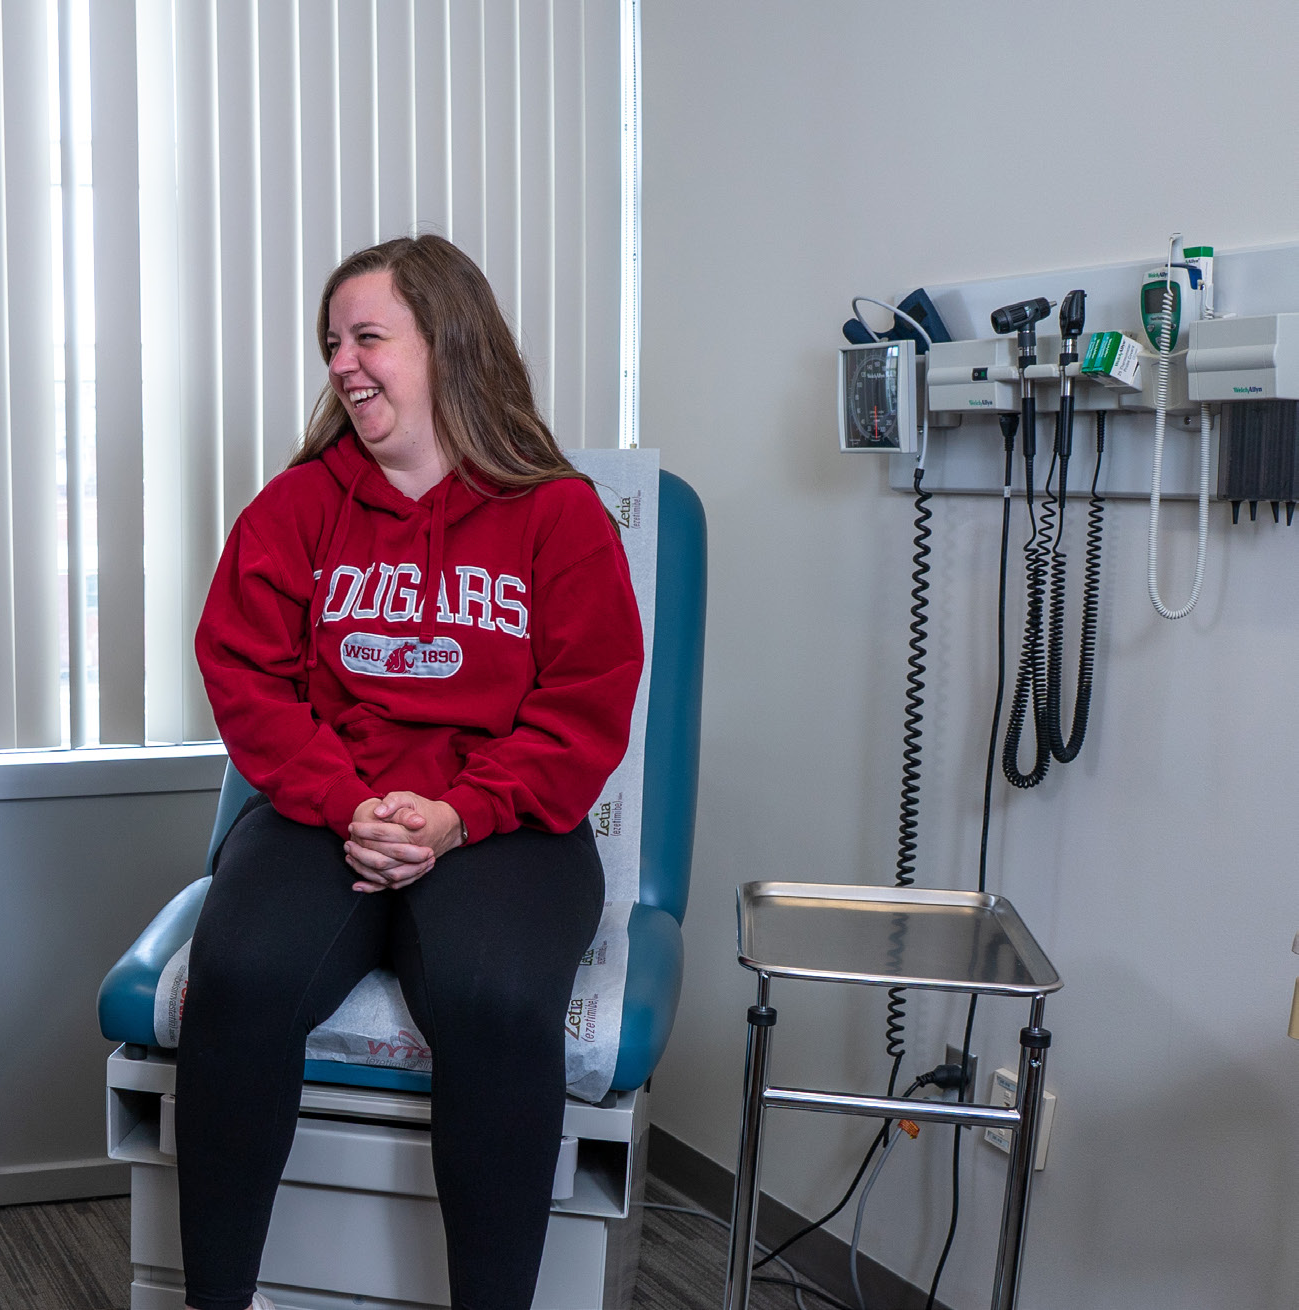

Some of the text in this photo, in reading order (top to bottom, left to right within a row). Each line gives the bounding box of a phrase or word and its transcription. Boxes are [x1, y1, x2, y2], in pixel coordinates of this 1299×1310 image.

[615, 496, 631, 529] Zetia
[313, 562, 528, 638] OUGARS
[344, 643, 459, 663] WSU 1890
[594, 801, 611, 838] Zetia
[610, 800, 623, 837] (ezetimibe)
[565, 998, 583, 1041] Zetia
